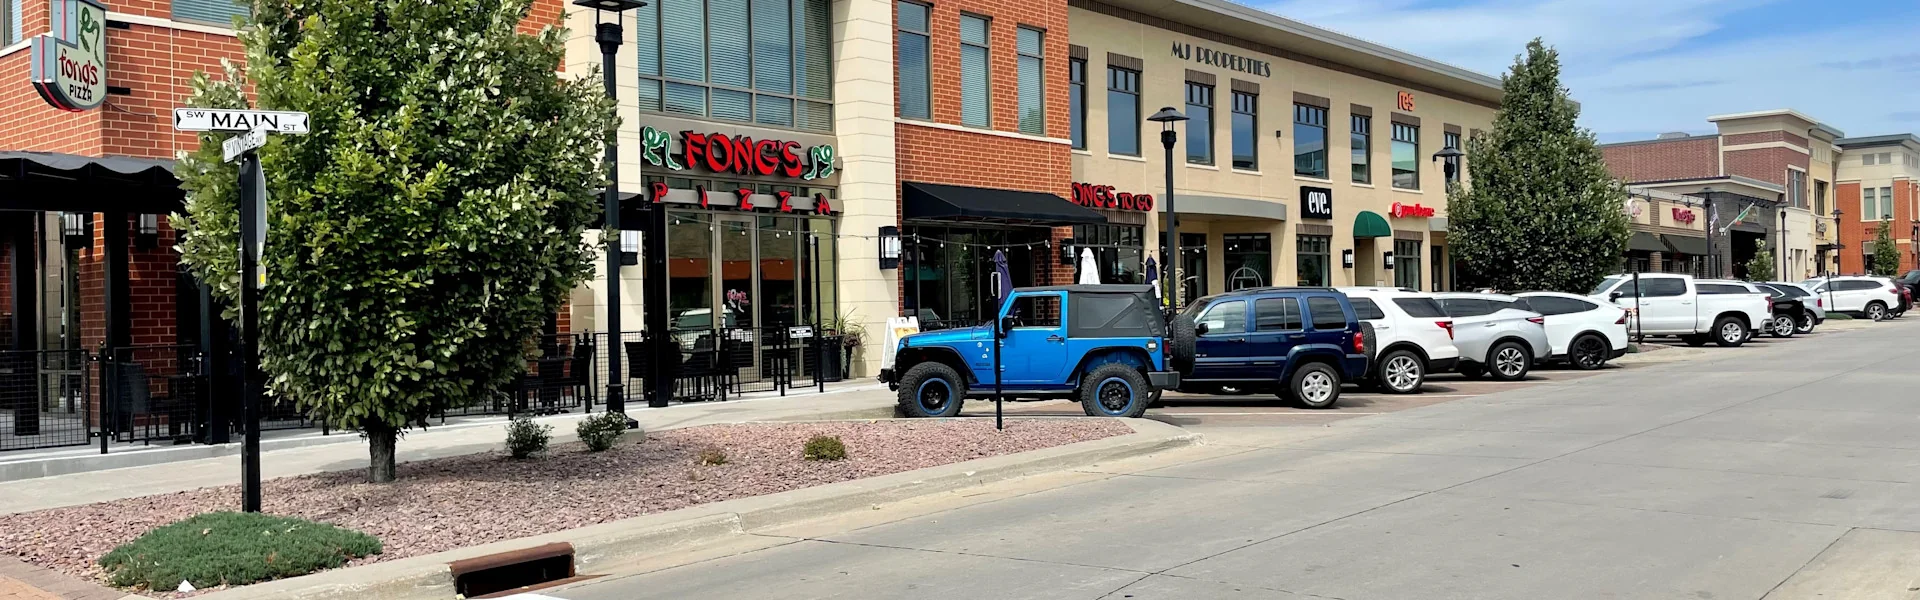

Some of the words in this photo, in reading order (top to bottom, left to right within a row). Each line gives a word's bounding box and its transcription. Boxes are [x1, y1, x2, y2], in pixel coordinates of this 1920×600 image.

[59, 48, 98, 90] fong's
[1171, 41, 1190, 60] MJ
[1196, 46, 1271, 78] PROPERTIES
[69, 84, 92, 101] PIZZA
[211, 112, 278, 130] MAIN
[681, 130, 803, 178] FONG'S
[651, 181, 831, 215] PIZZA
[1072, 182, 1116, 208] ONG'S
[1117, 192, 1134, 210] TO
[1134, 194, 1154, 211] GO
[1308, 191, 1330, 214] eve.
